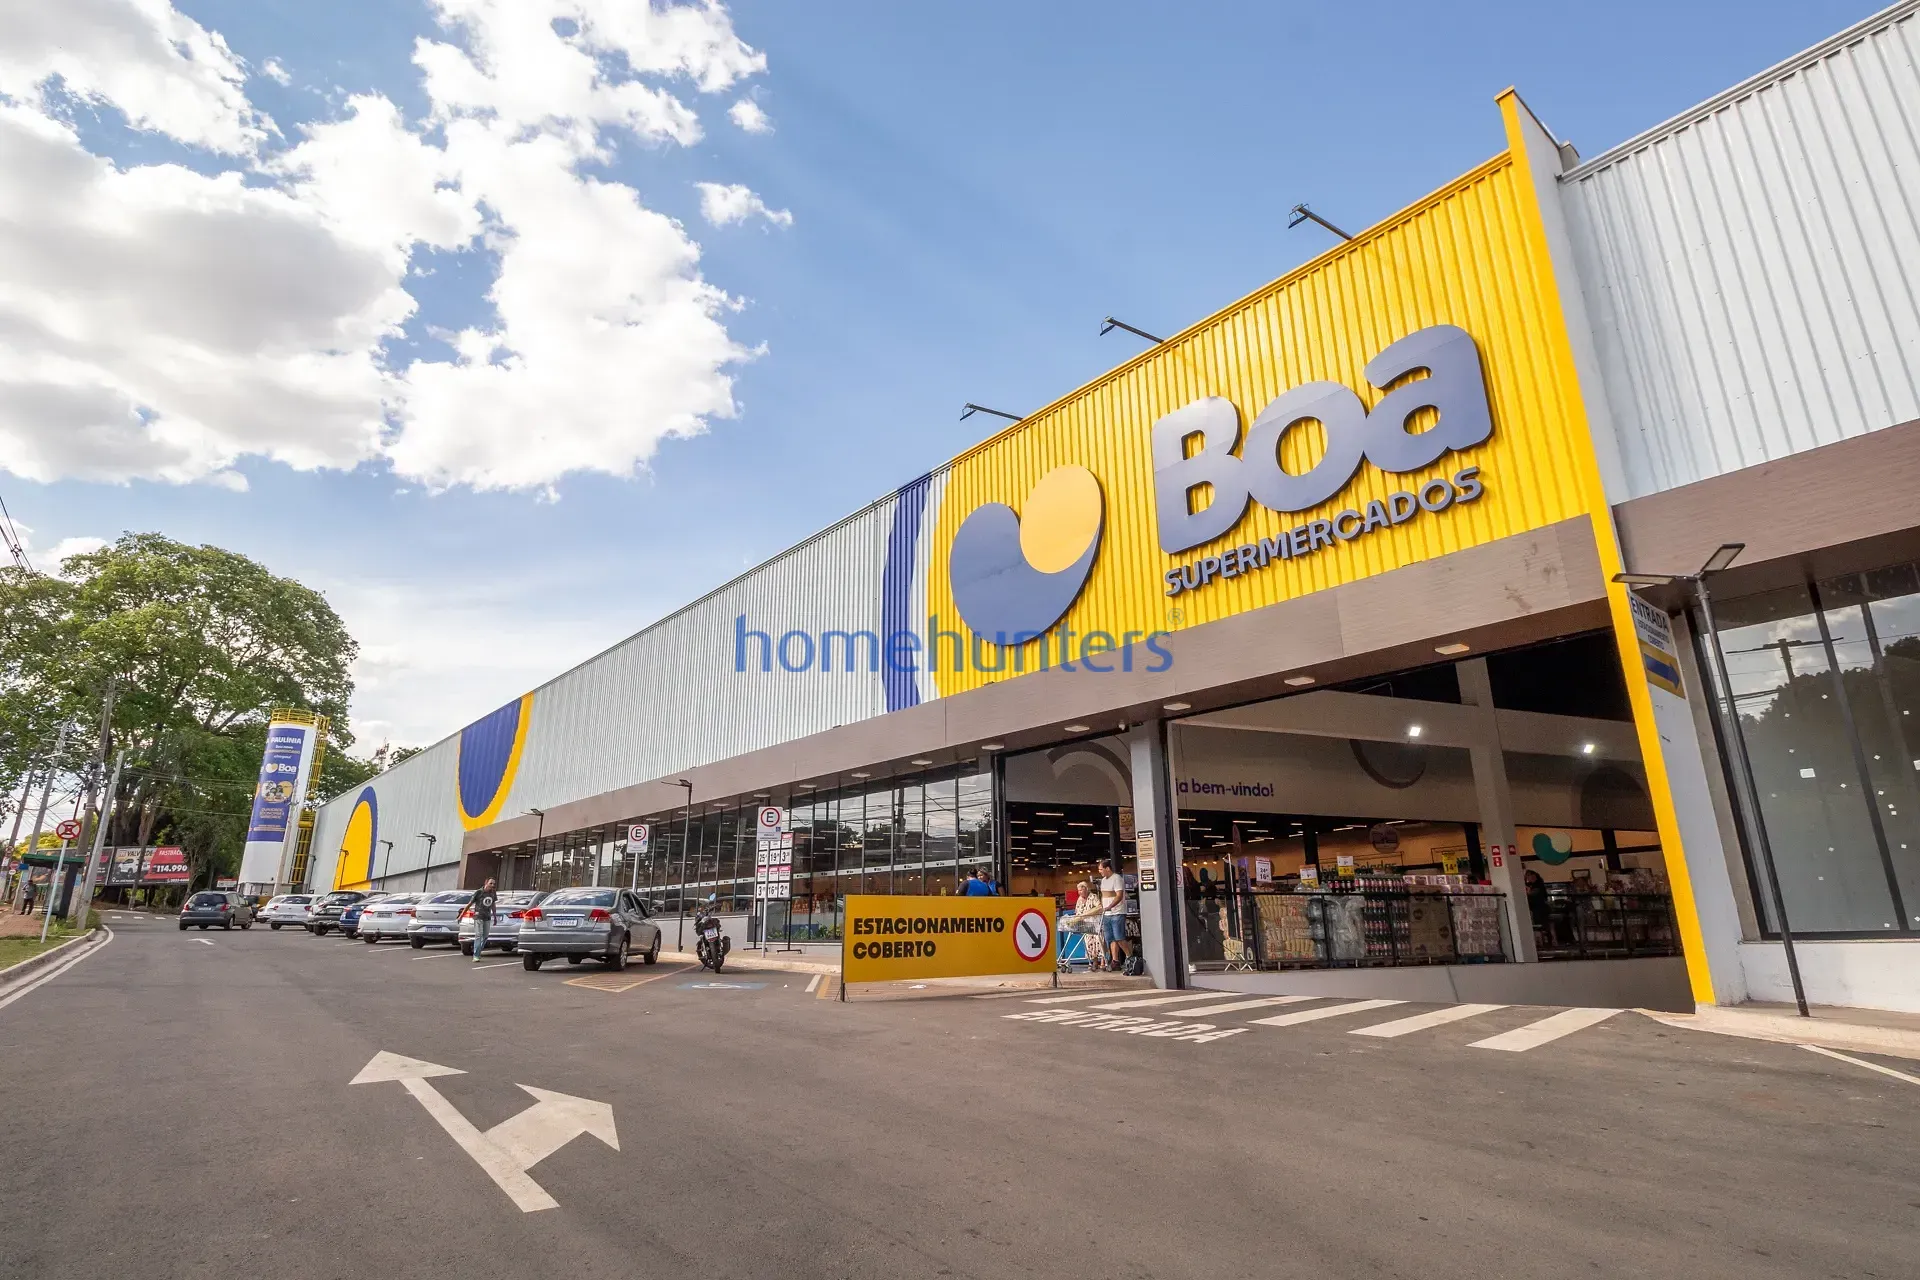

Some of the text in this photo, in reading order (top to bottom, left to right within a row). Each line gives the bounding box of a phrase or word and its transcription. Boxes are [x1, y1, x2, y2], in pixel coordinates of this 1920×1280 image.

[1152, 324, 1494, 555] Boa
[1164, 466, 1484, 598] SUPERMERCADOS
[1630, 596, 1669, 633] ENTRADA
[278, 763, 297, 773] Boa
[1192, 778, 1274, 797] bem-vindo!
[853, 917, 1005, 935] ESTACIONAMENTO
[852, 940, 937, 960] COBERTO
[1000, 1009, 1250, 1043] ENTRADA
